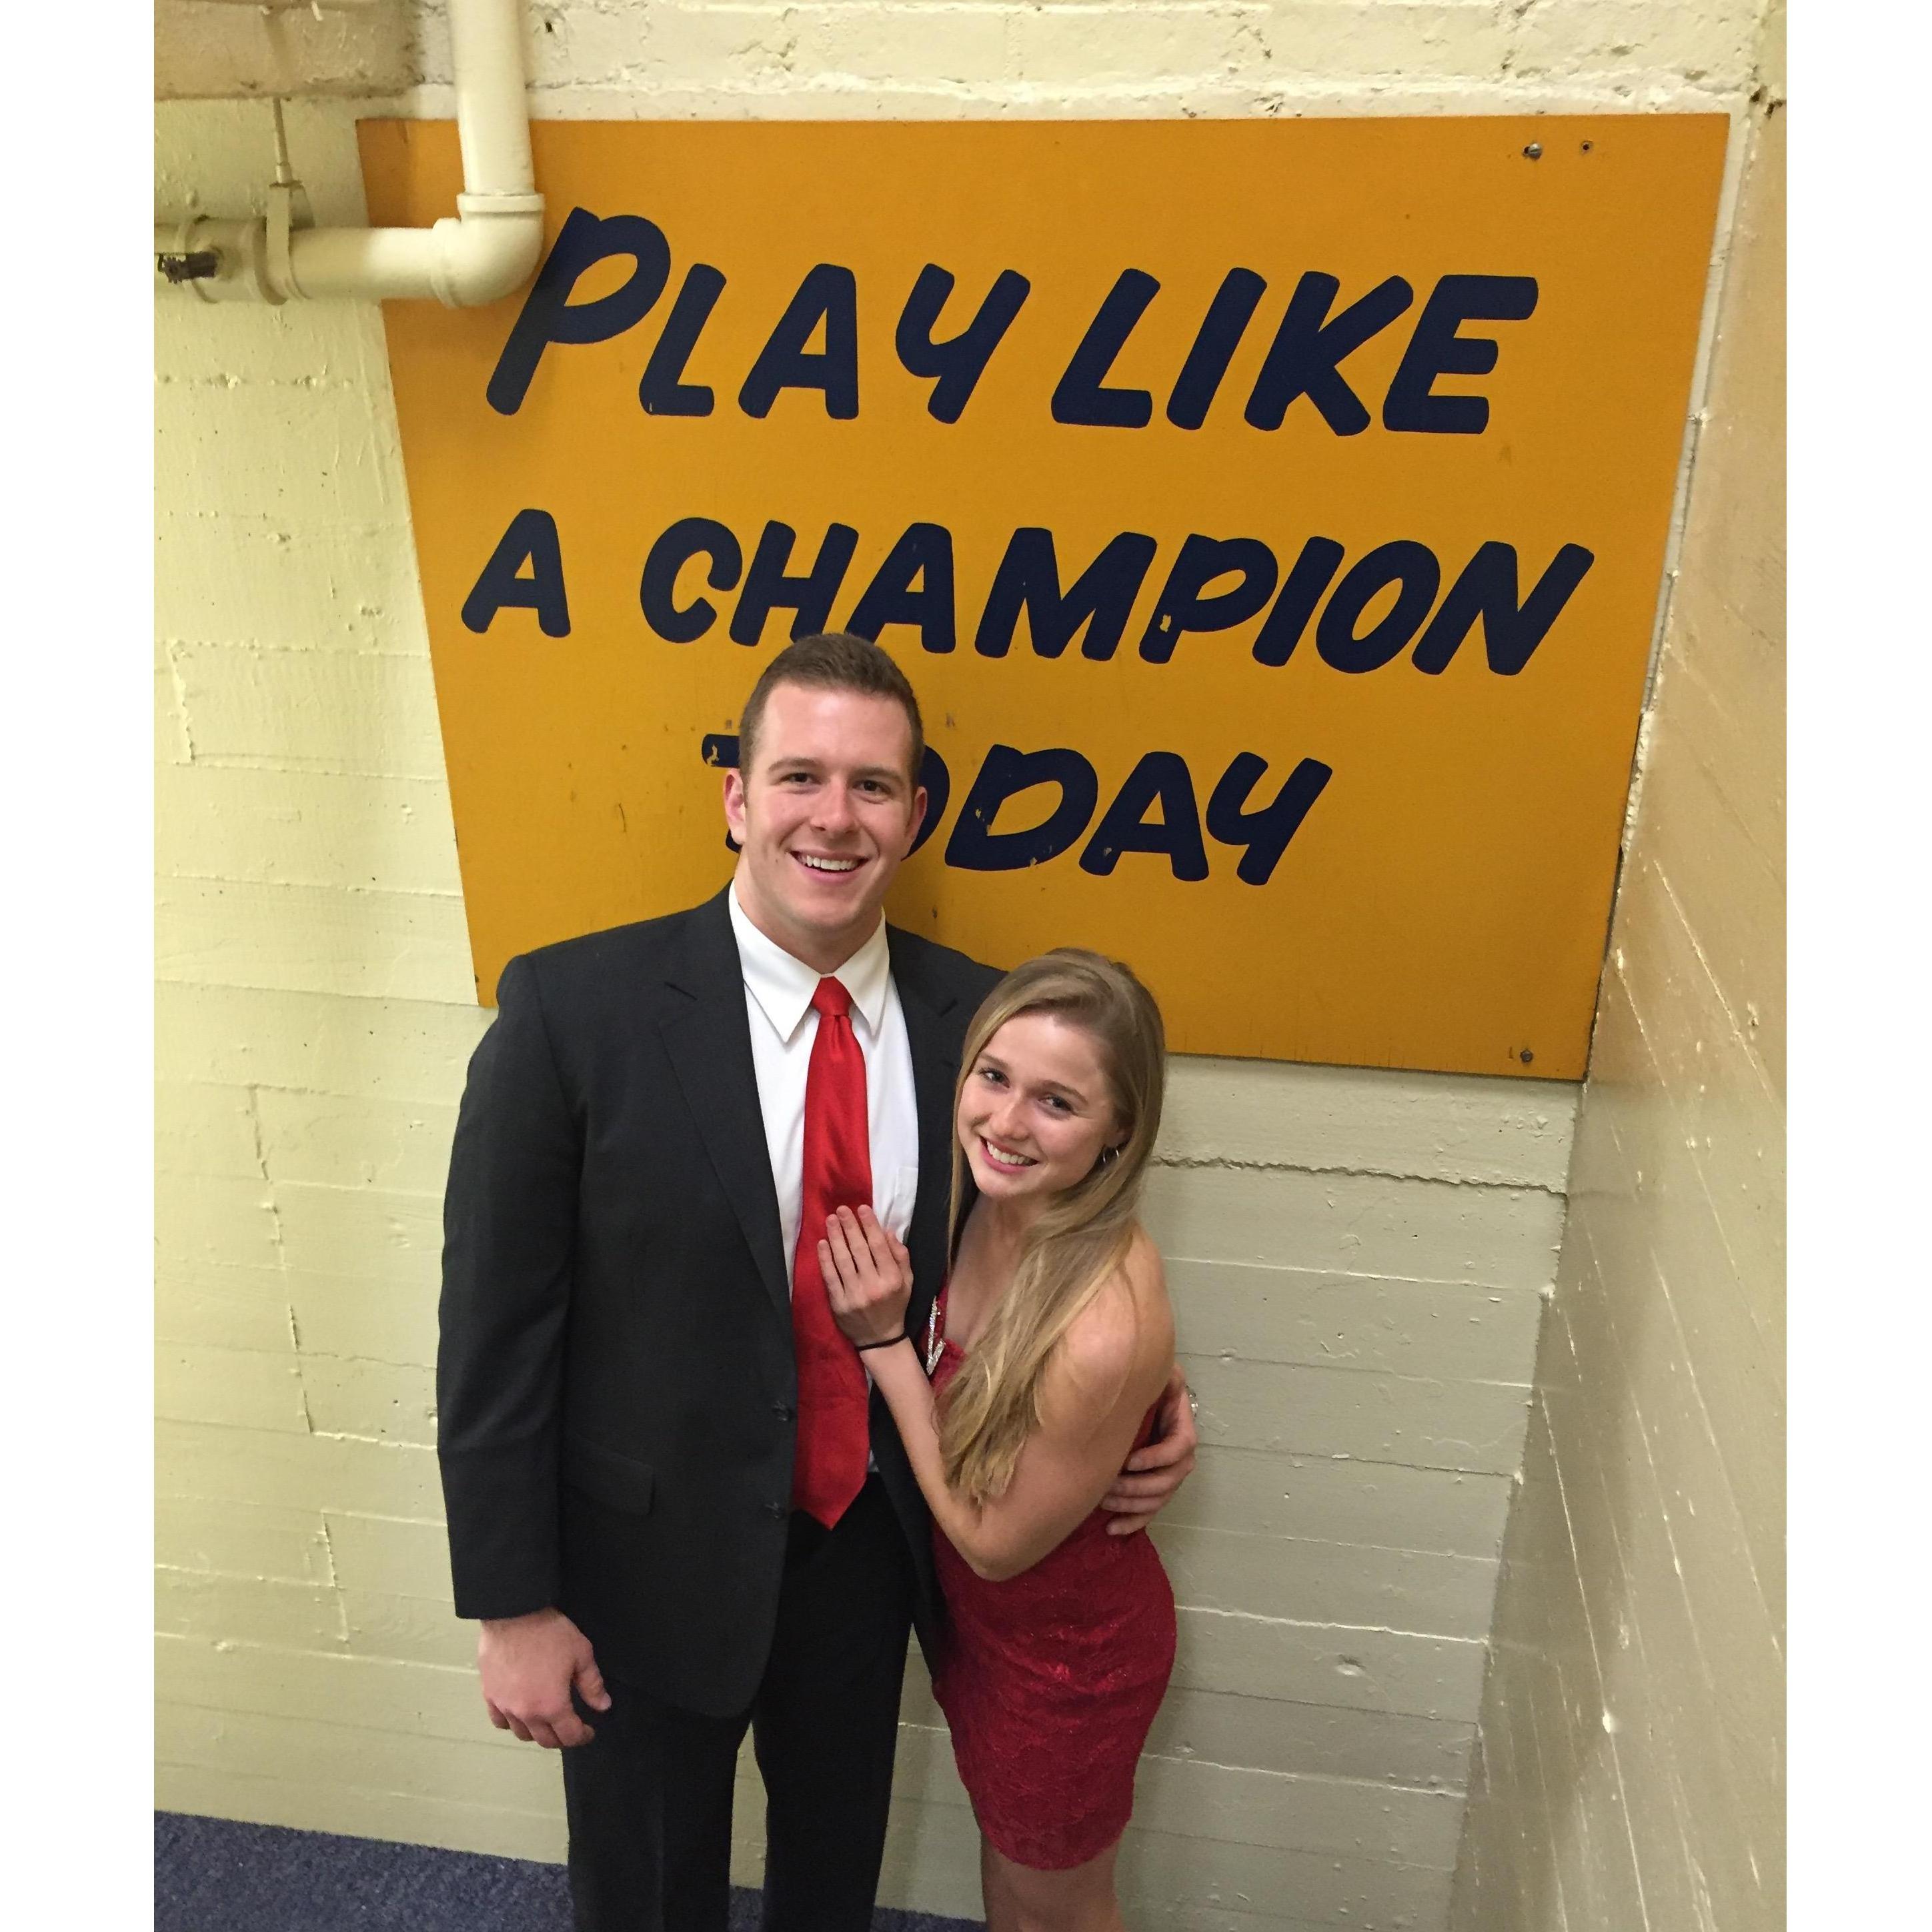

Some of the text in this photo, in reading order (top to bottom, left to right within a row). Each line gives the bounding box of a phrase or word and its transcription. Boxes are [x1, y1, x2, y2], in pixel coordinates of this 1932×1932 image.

[486, 206, 1539, 437] PLAY LIKE
[461, 509, 1595, 676] A CHAMPION
[702, 734, 1333, 886] DAY
